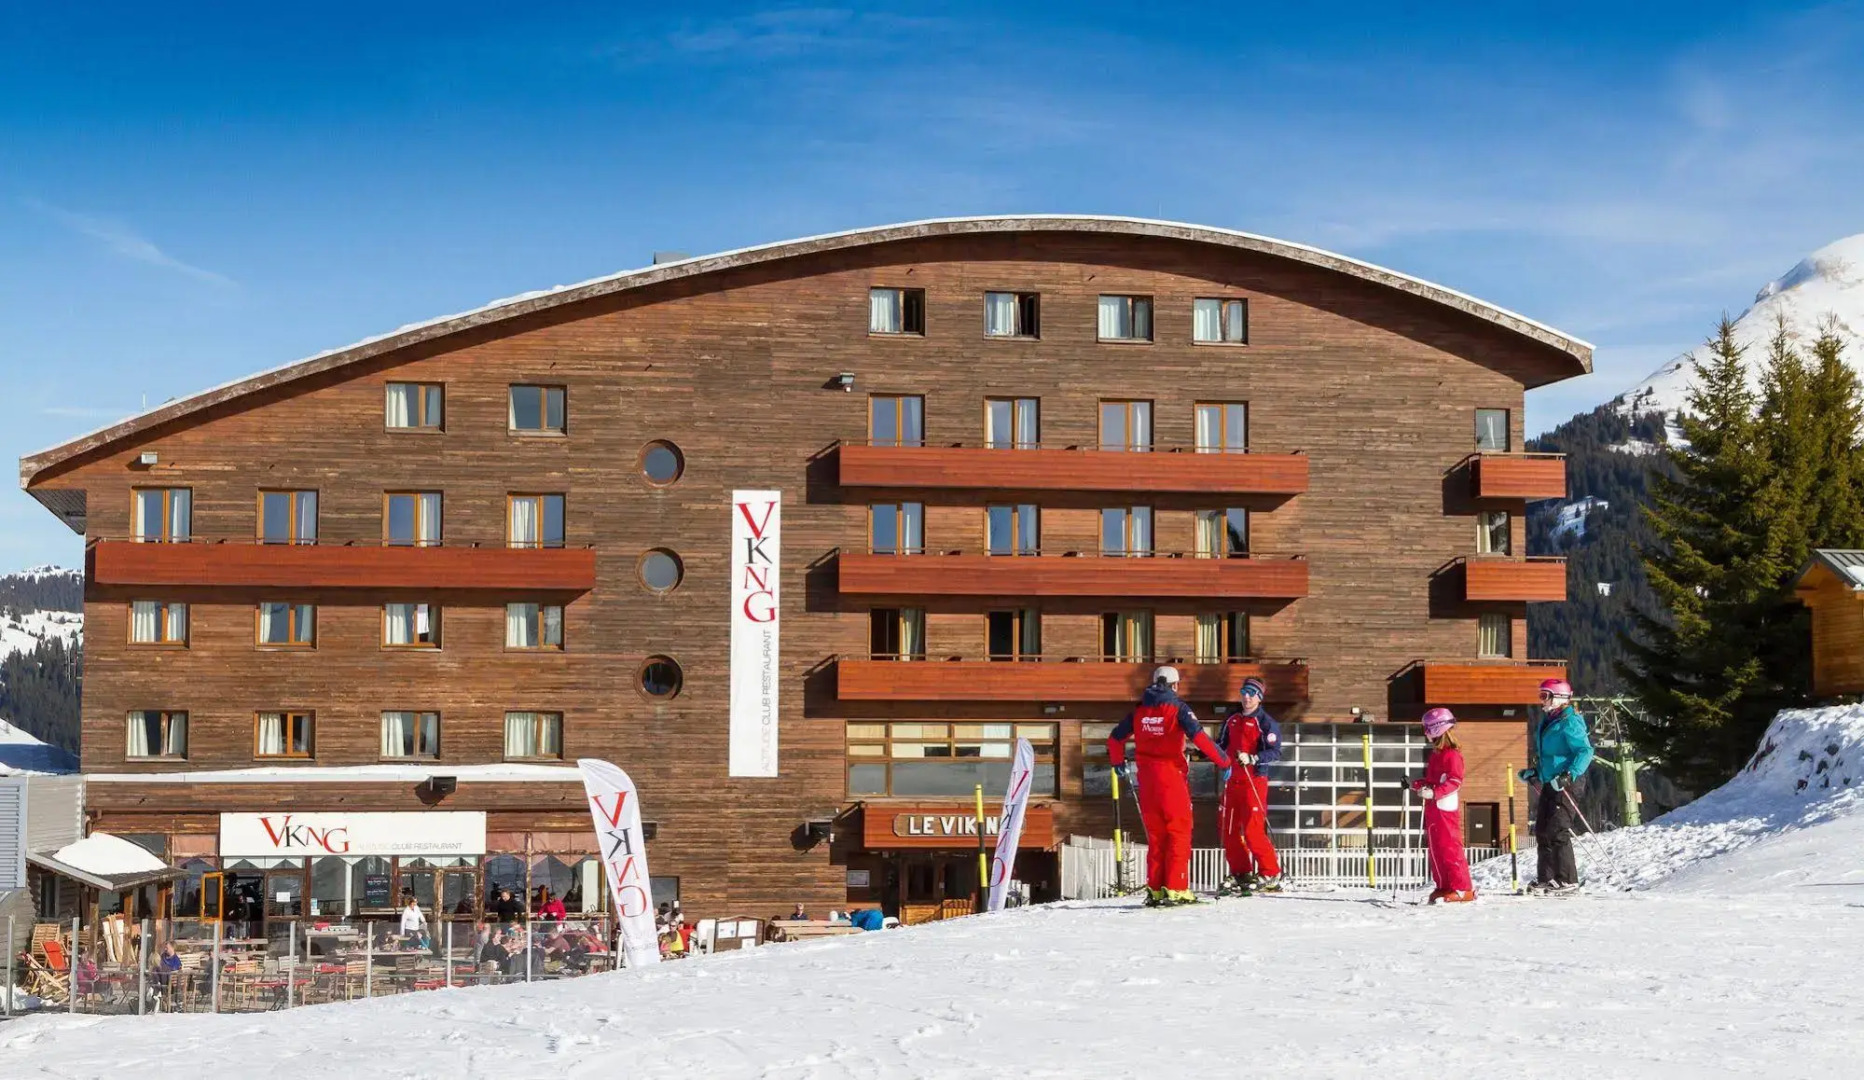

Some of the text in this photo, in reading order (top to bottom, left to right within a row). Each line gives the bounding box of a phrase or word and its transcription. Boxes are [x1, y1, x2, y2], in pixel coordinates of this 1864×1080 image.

[737, 501, 776, 623] VKNG
[762, 629, 771, 695] RESTAURANT
[762, 698, 771, 725] CLUB
[258, 815, 350, 854] VKNG
[909, 816, 999, 835] LE VIKN
[413, 842, 463, 850] RESTAURANT
